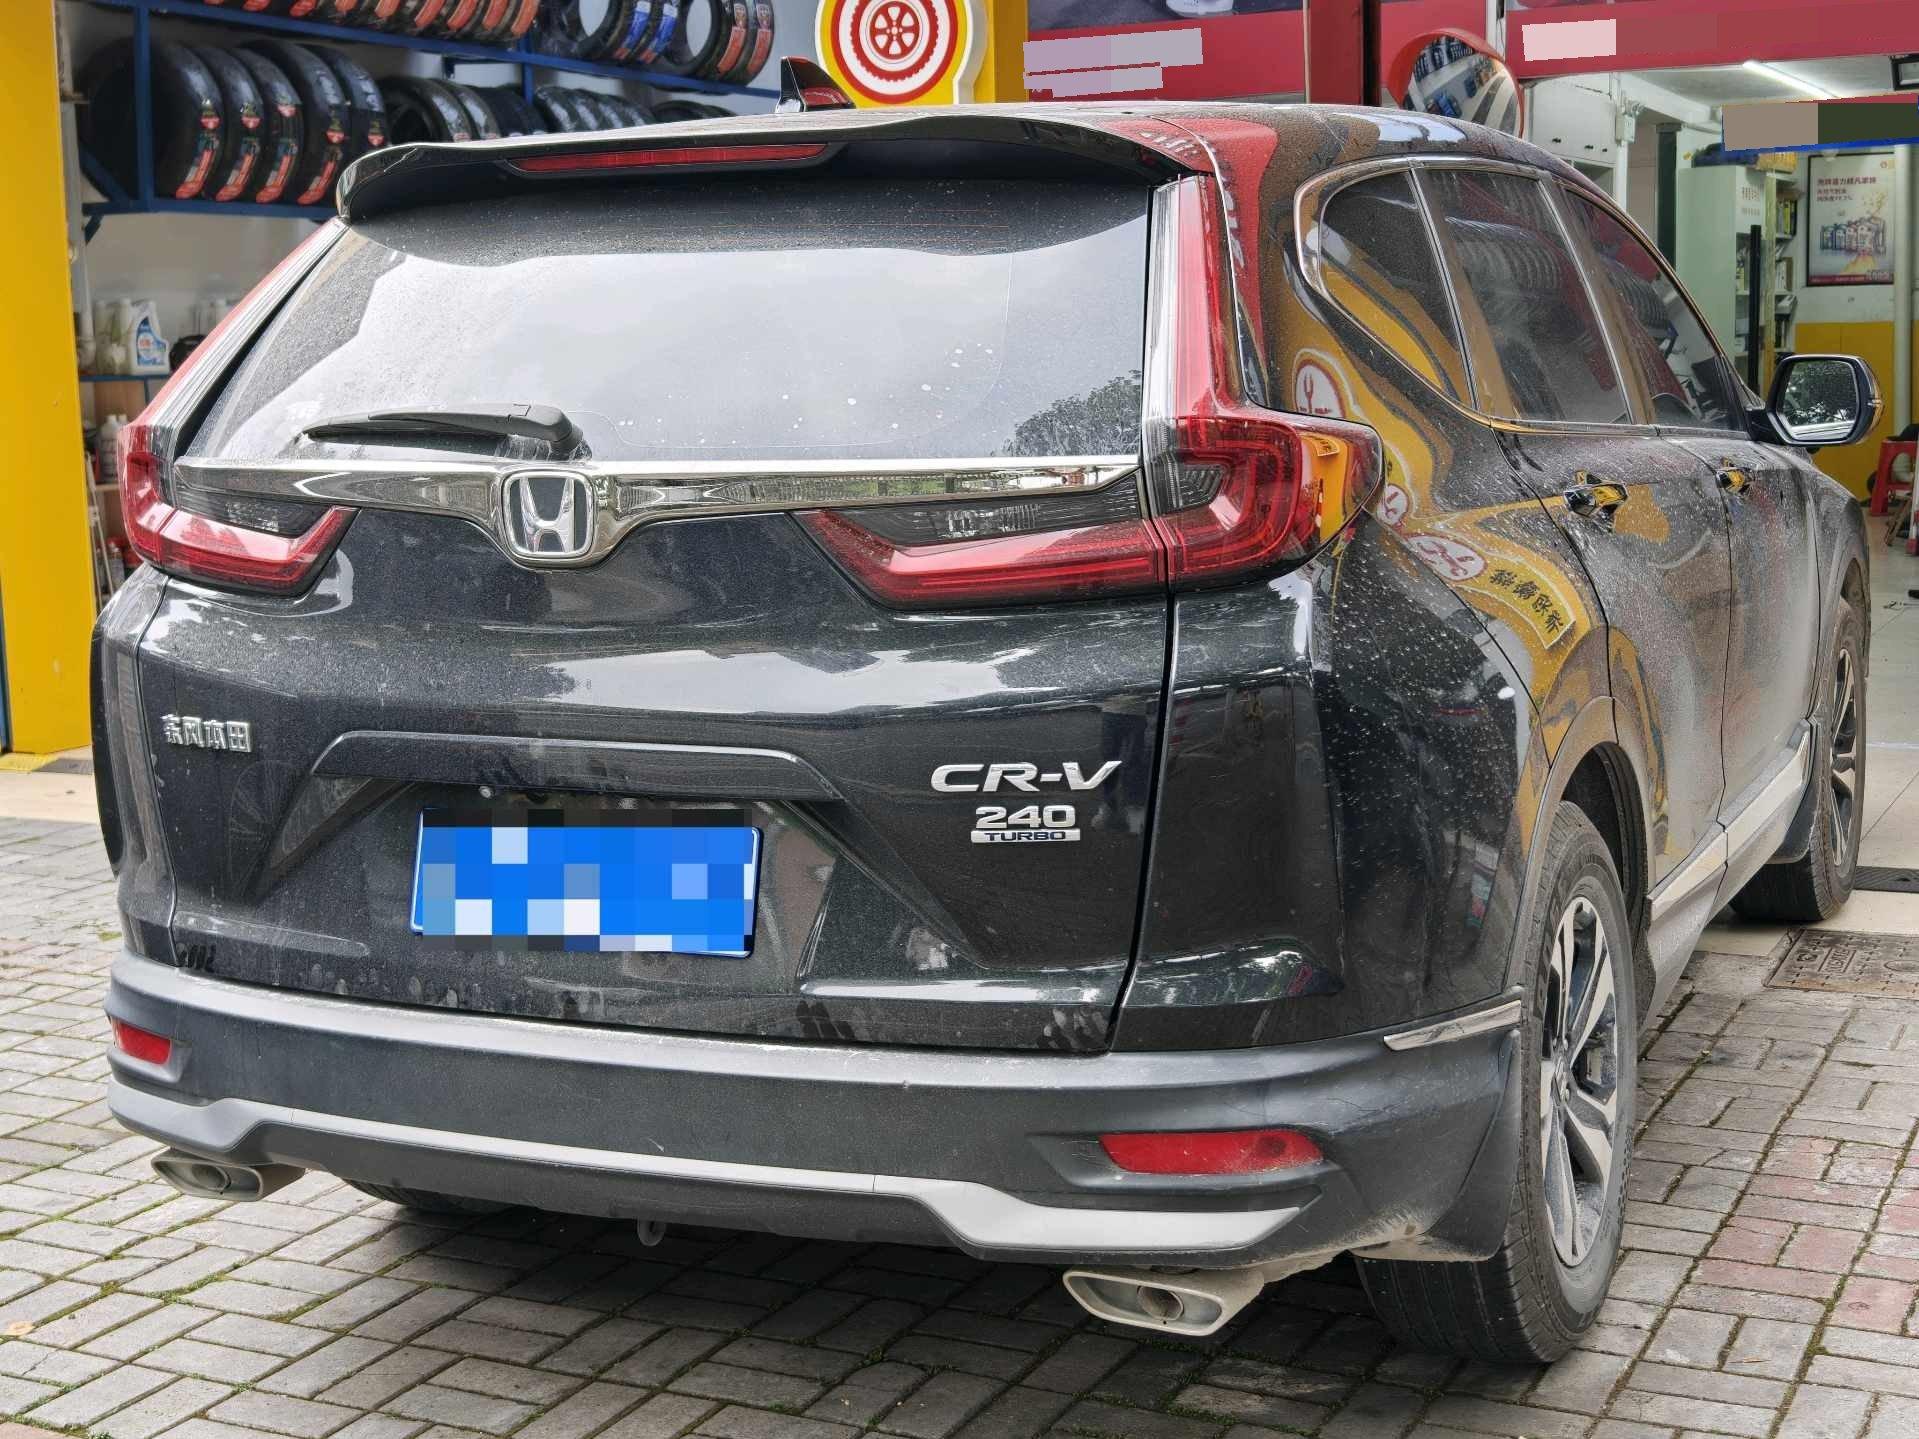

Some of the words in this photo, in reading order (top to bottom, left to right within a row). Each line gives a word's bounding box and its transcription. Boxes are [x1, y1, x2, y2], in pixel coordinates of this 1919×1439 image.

[160, 713, 252, 753] 东风本田
[930, 760, 1123, 792] CR-V
[975, 805, 1076, 829] 240
[984, 831, 1066, 841] TURBO
